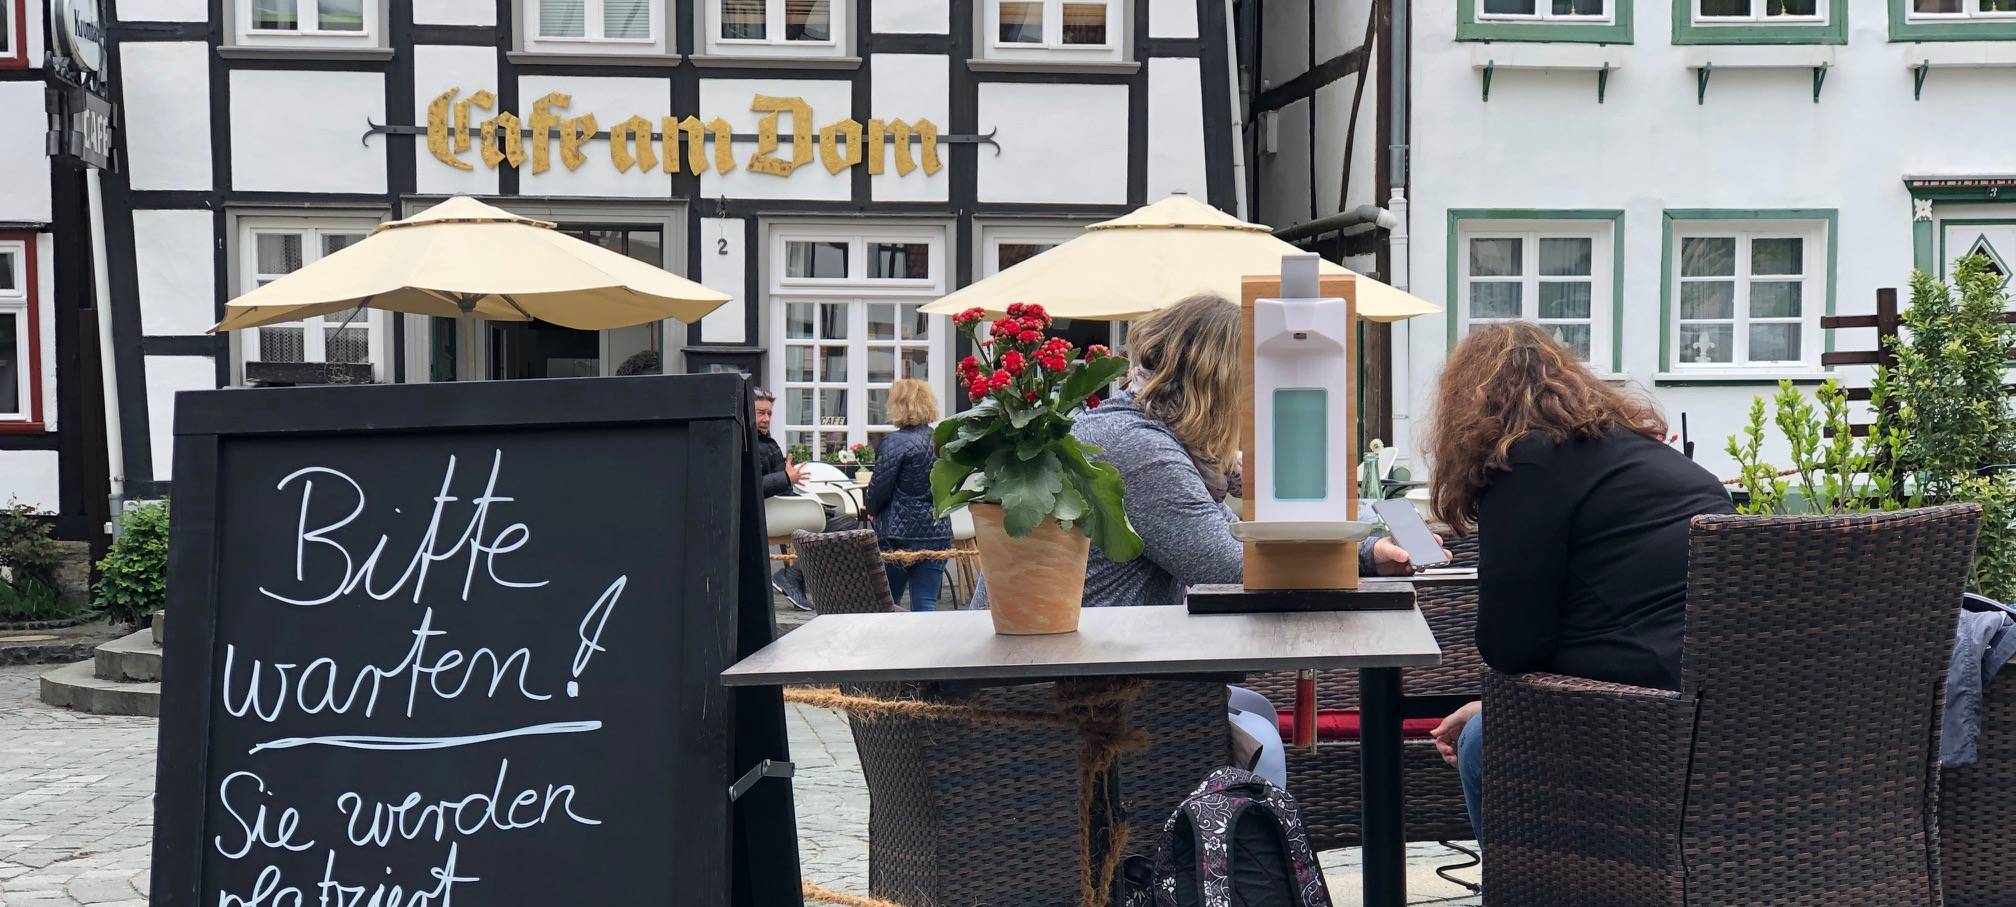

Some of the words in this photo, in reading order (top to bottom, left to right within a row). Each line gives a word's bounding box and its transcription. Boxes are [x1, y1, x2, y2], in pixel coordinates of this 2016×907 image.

[83, 108, 109, 157] CAFE
[427, 86, 597, 175] Cafe
[610, 113, 738, 176] am
[746, 93, 943, 178] Dom
[1989, 187, 1998, 197] 3
[717, 238, 728, 255] 2
[259, 448, 550, 606] Bitte
[222, 574, 628, 723] warten!
[214, 771, 315, 859] Sie
[336, 758, 603, 848] werden
[218, 842, 481, 907] latziert
